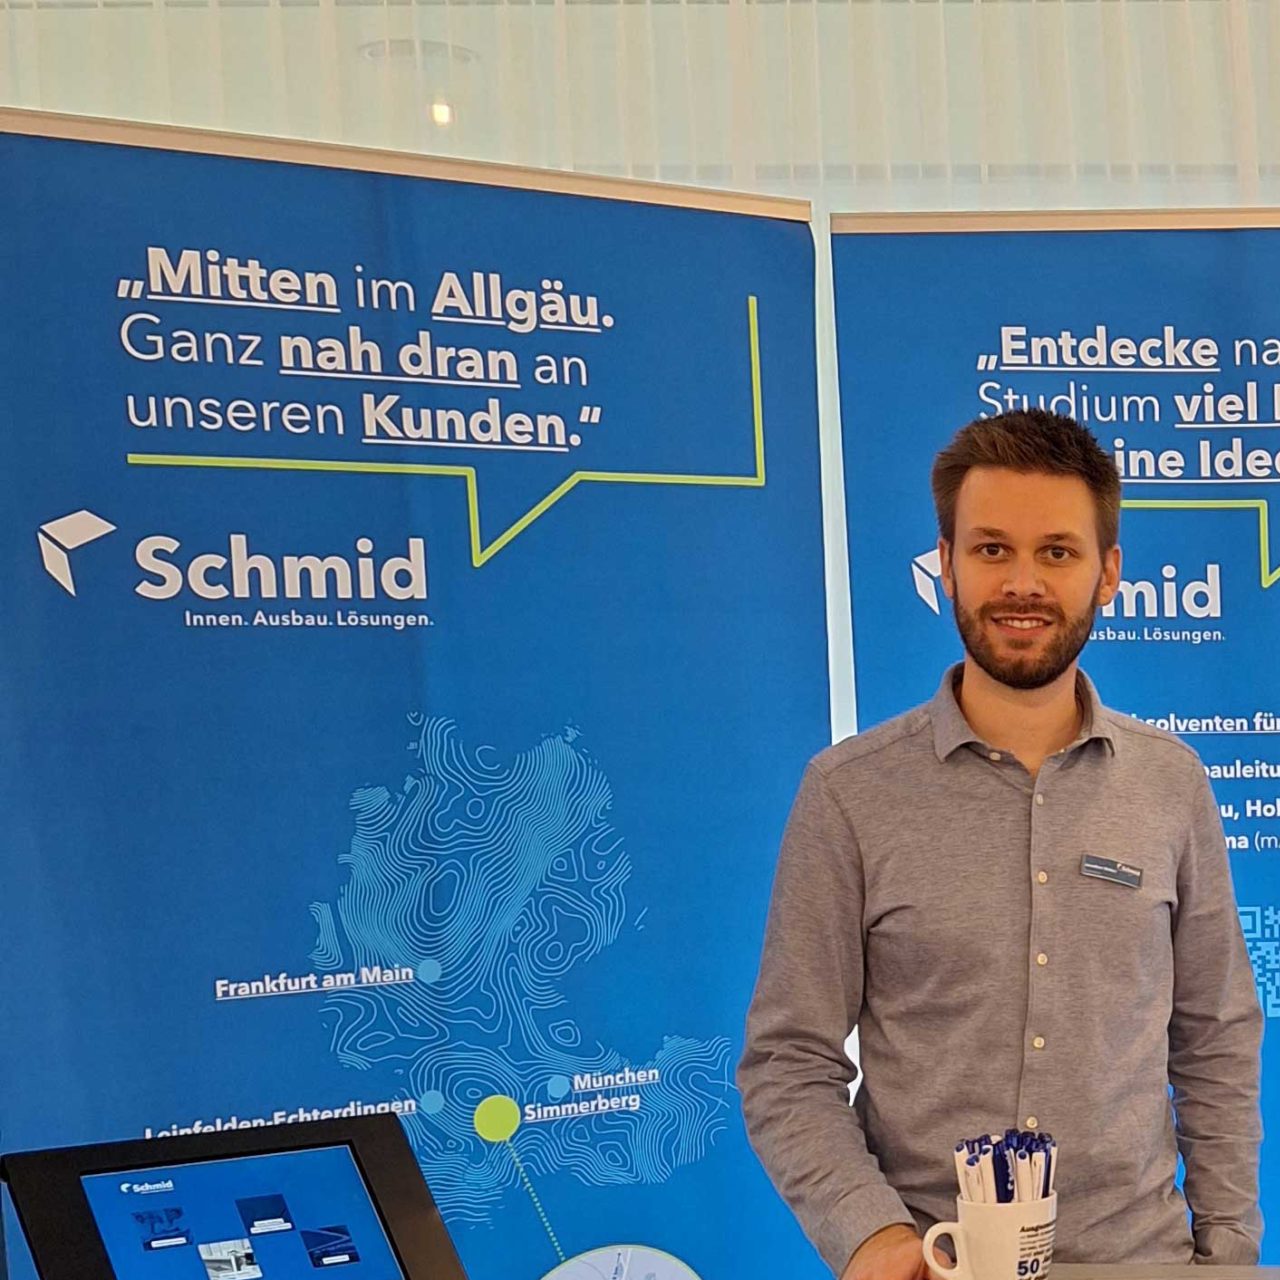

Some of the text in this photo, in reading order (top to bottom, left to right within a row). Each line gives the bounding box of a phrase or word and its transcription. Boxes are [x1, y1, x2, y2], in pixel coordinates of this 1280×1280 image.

[117, 247, 614, 333] „Mitten im Allgäu.
[120, 313, 588, 386] Ganz nah dran an
[977, 326, 1219, 371] „Entdecke
[978, 381, 1160, 422] Studium
[1175, 381, 1258, 423] viel
[127, 393, 601, 446] unseren Kunden.“
[1114, 438, 1186, 478] ine
[134, 534, 428, 600] Schmid
[1101, 564, 1221, 618] mid
[185, 610, 435, 629] Innen. Ausbau. Lösungen.
[1088, 627, 1226, 644] usbau. Lösungen.
[1131, 713, 1248, 732] solventen
[1220, 804, 1239, 820] u,
[215, 964, 414, 998] Frankfurt am Main
[573, 1068, 660, 1091] München
[524, 1094, 641, 1121] Simmerberg
[132, 1179, 174, 1192] Schmid
[1017, 1258, 1039, 1276] 50
